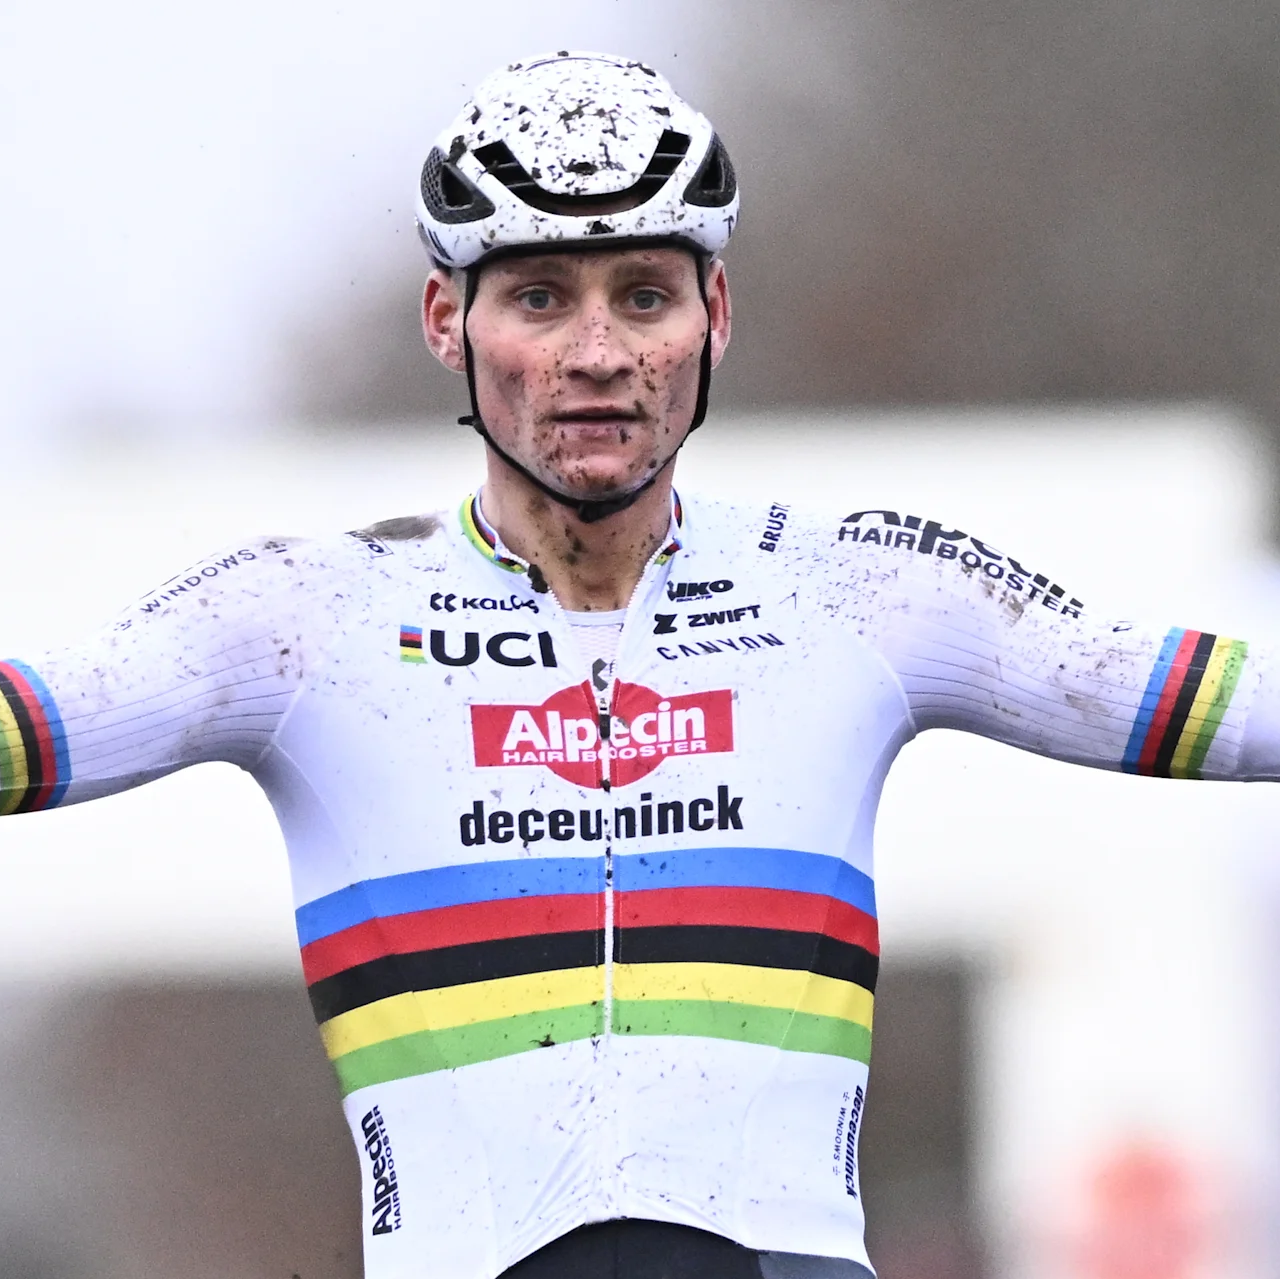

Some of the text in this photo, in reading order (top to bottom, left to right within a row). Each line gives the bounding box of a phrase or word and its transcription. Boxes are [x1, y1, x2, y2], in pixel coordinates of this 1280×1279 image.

[758, 501, 791, 553] BRUST
[140, 549, 257, 613] WINDOWS
[837, 526, 1084, 619] HAIR BOOSTER
[687, 604, 761, 628] ZWIFT
[430, 628, 558, 668] UCI
[656, 632, 785, 660] CANYON
[501, 701, 706, 762] Alpecin
[502, 739, 708, 763] HAIR BOOSTER
[459, 785, 744, 847] deceuninck
[833, 1107, 847, 1161] WINDOWS
[845, 1085, 864, 1200] deceuninck
[361, 1110, 399, 1236] Alpecin
